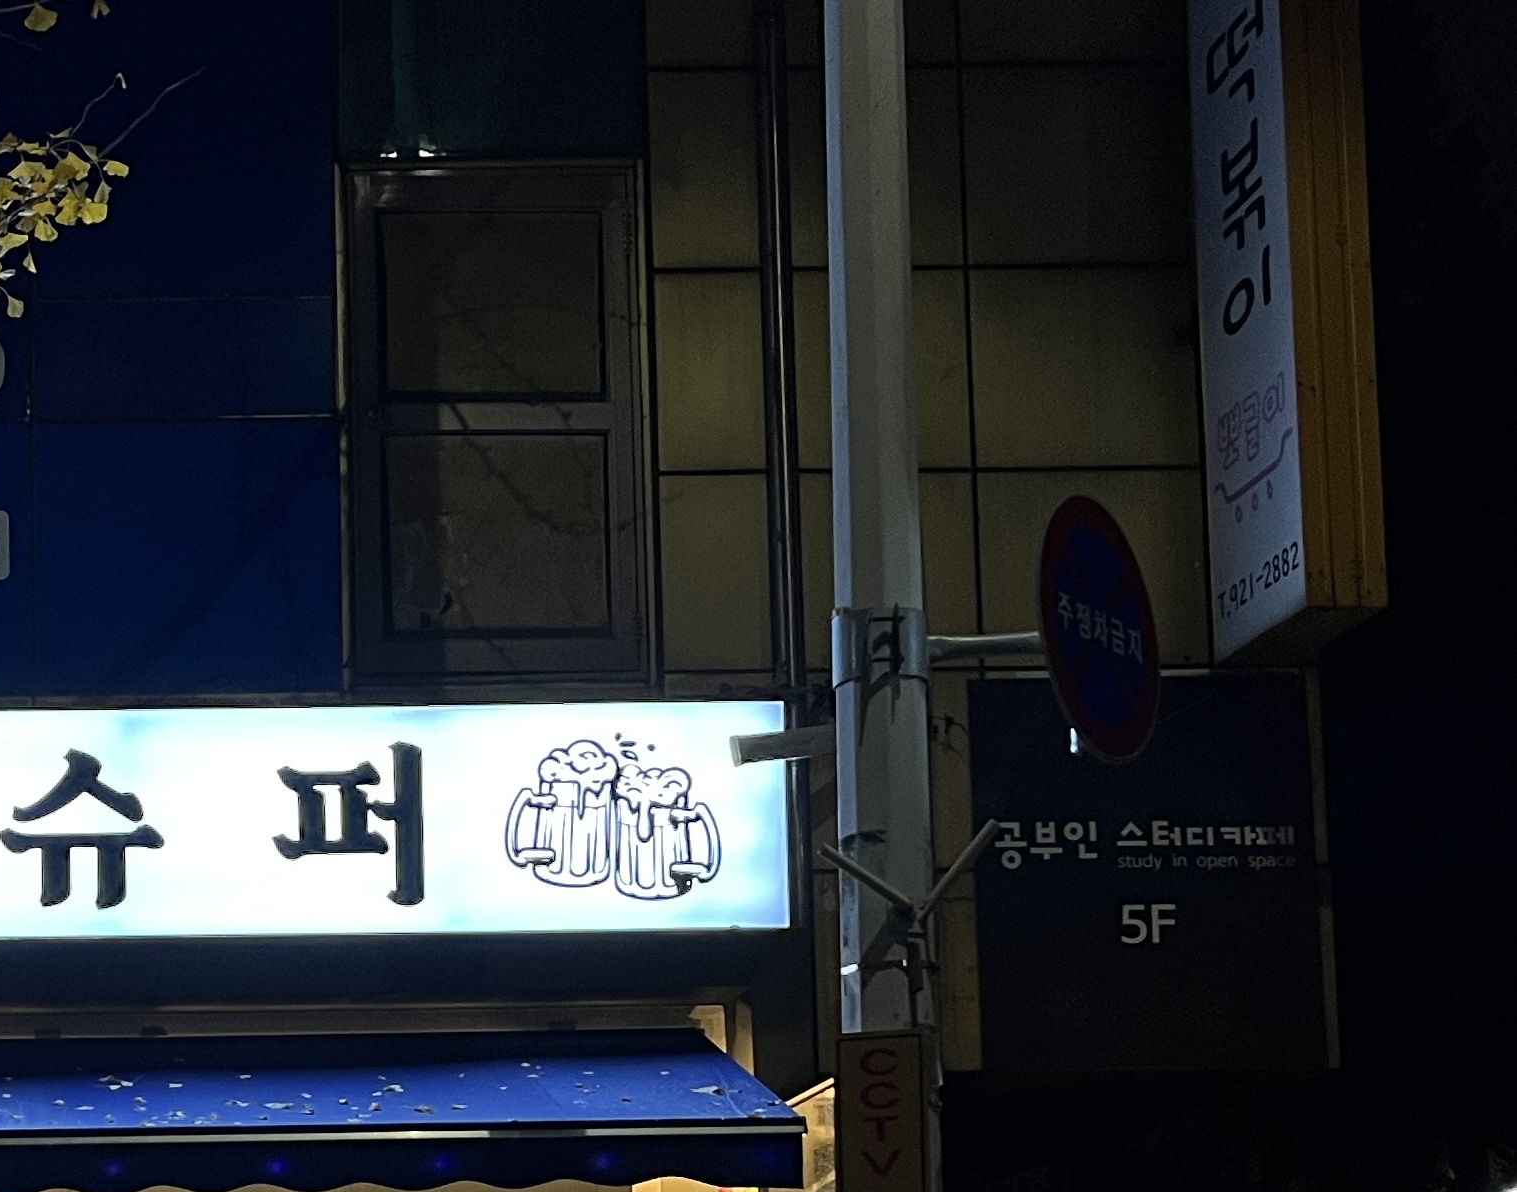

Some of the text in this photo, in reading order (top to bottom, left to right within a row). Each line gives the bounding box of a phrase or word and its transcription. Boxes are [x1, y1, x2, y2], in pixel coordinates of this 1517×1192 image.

[1207, 0, 1271, 336] 떡볶이
[1057, 590, 1144, 665] 주정차금지
[994, 819, 1296, 870] 공부인 스터디카페
[1117, 852, 1296, 871] study in open space
[1120, 903, 1177, 945] 5F
[859, 1048, 900, 1177] CCTV
